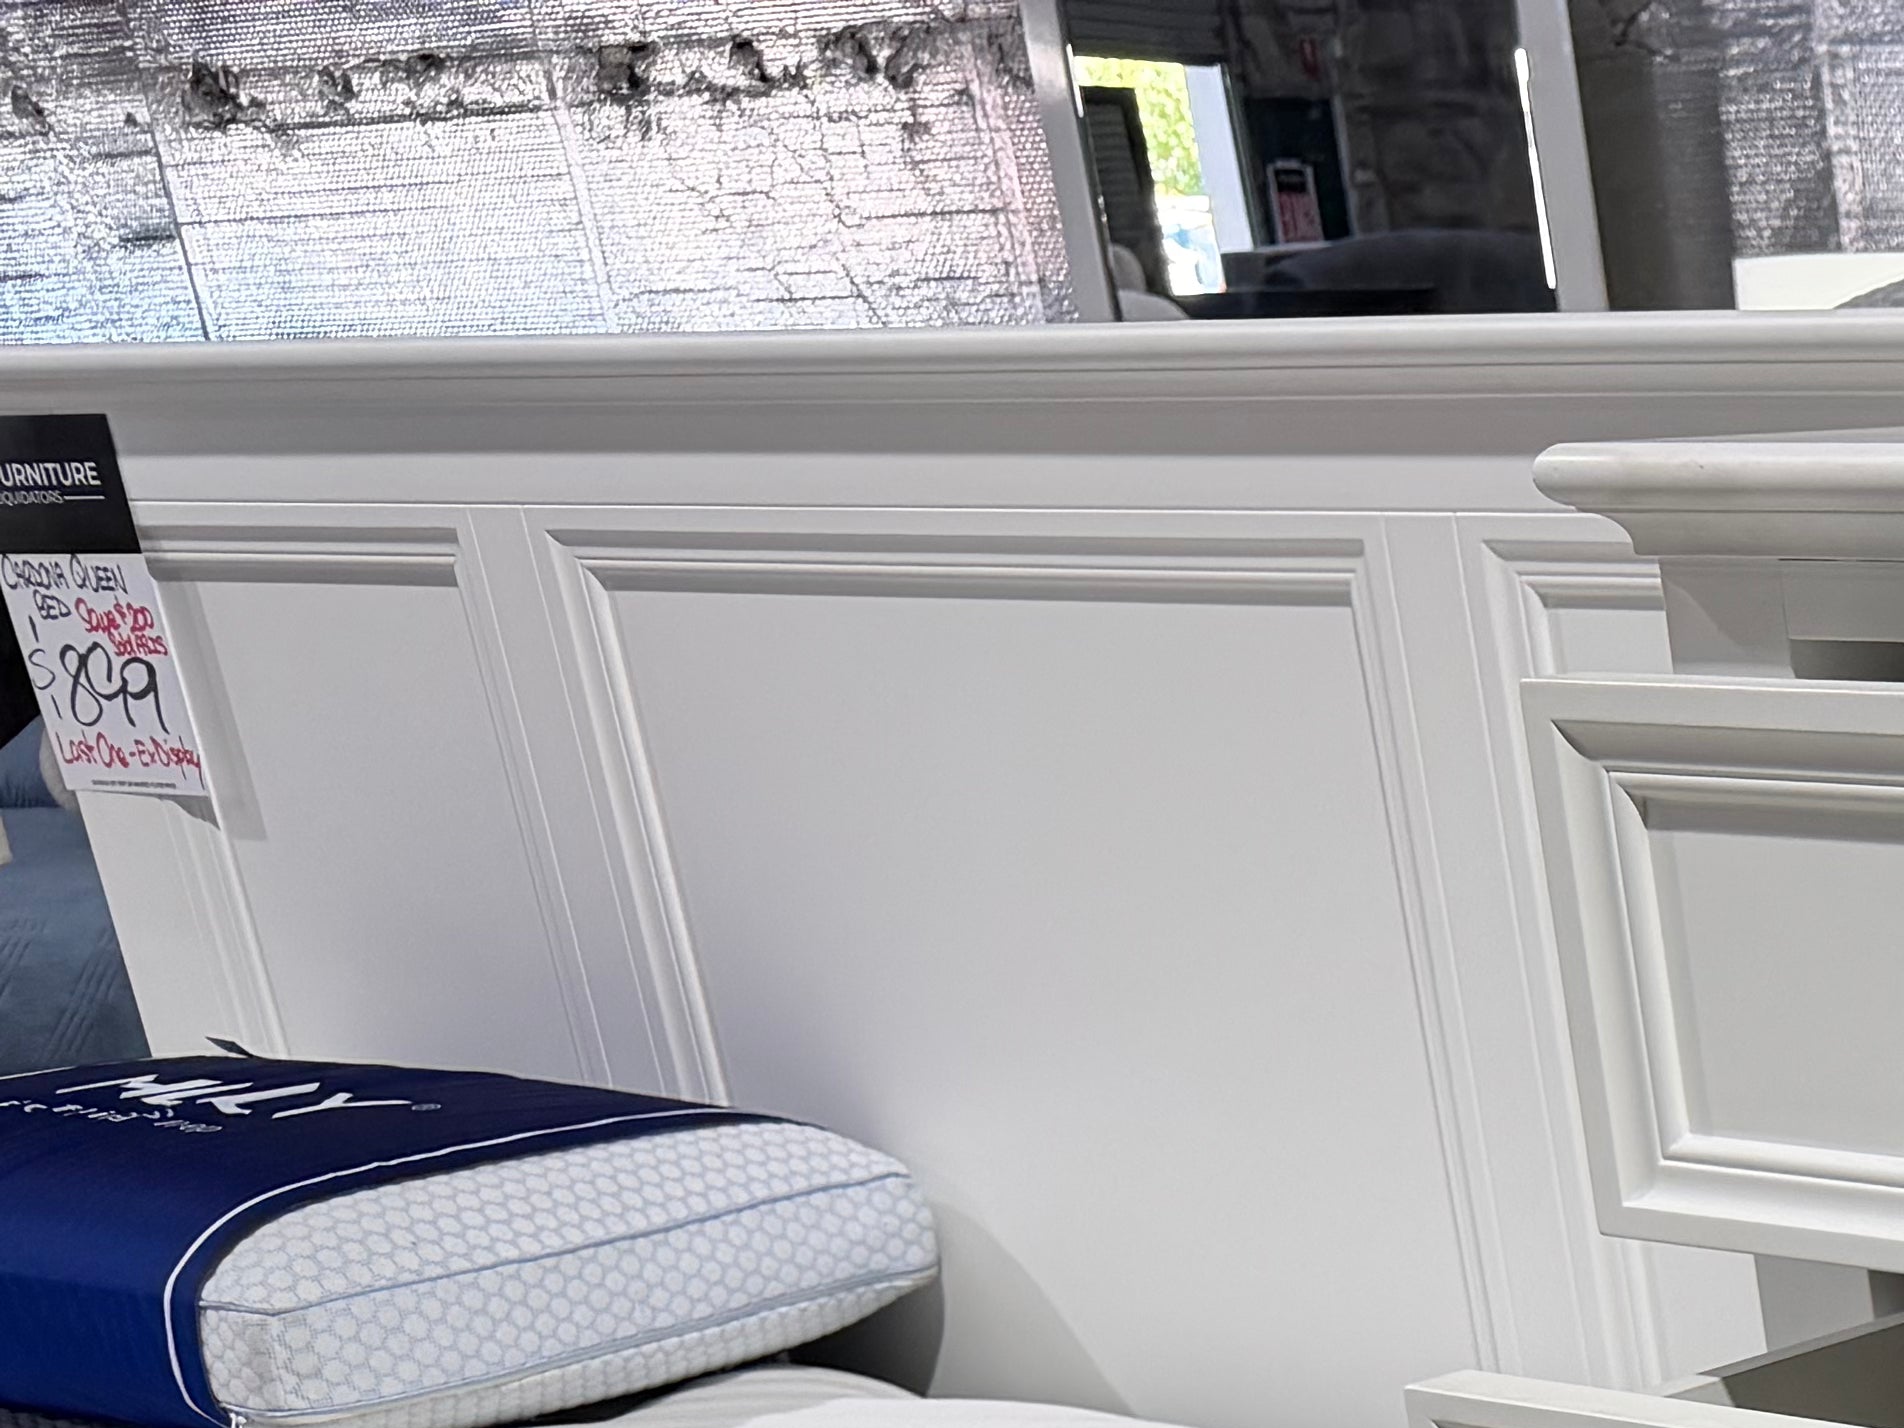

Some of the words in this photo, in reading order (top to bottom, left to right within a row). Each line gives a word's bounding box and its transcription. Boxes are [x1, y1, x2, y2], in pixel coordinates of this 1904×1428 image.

[69, 553, 129, 594] QUEEN
[33, 589, 72, 620] BED
[75, 597, 121, 633] Save
[56, 730, 97, 764] Last
[96, 732, 129, 768] One
